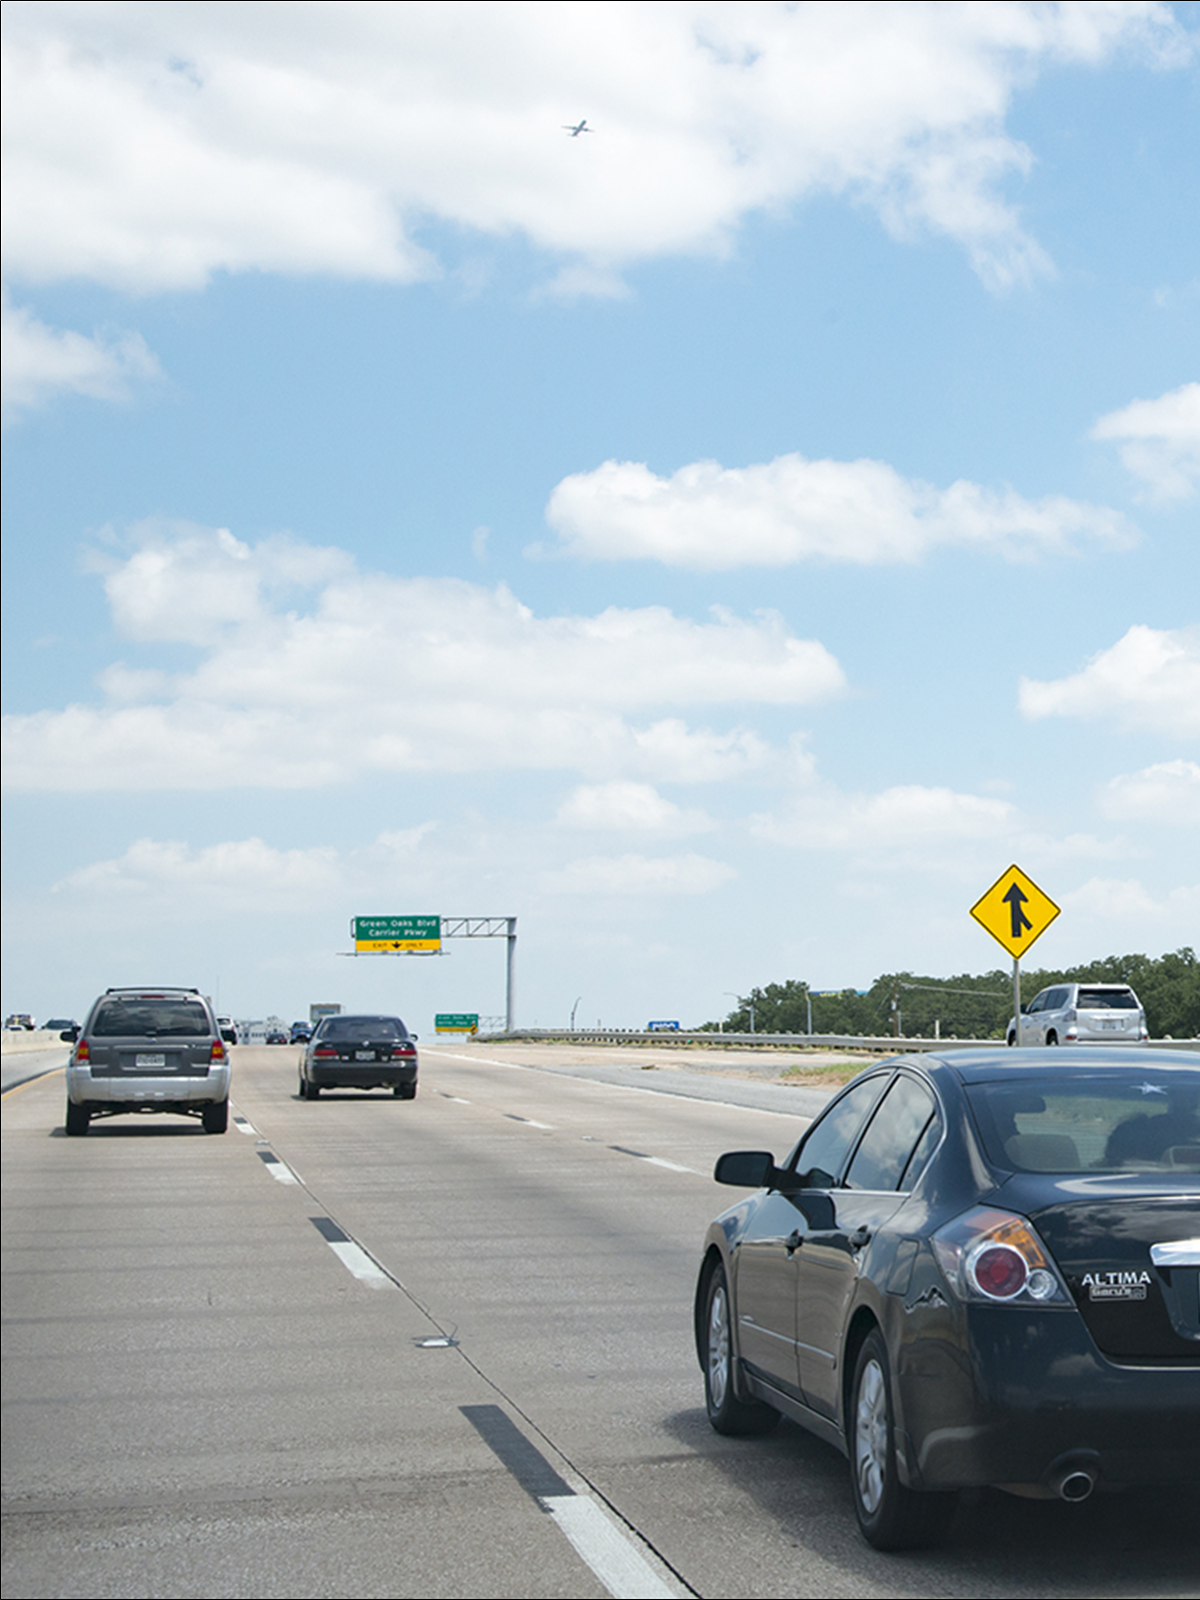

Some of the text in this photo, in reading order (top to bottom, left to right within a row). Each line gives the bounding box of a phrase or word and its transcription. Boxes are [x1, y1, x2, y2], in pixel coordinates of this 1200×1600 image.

[360, 919, 437, 927] Green Oaks Blvd
[368, 929, 428, 937] Carrier Pkwy
[1081, 1271, 1152, 1287] ALTIMA
